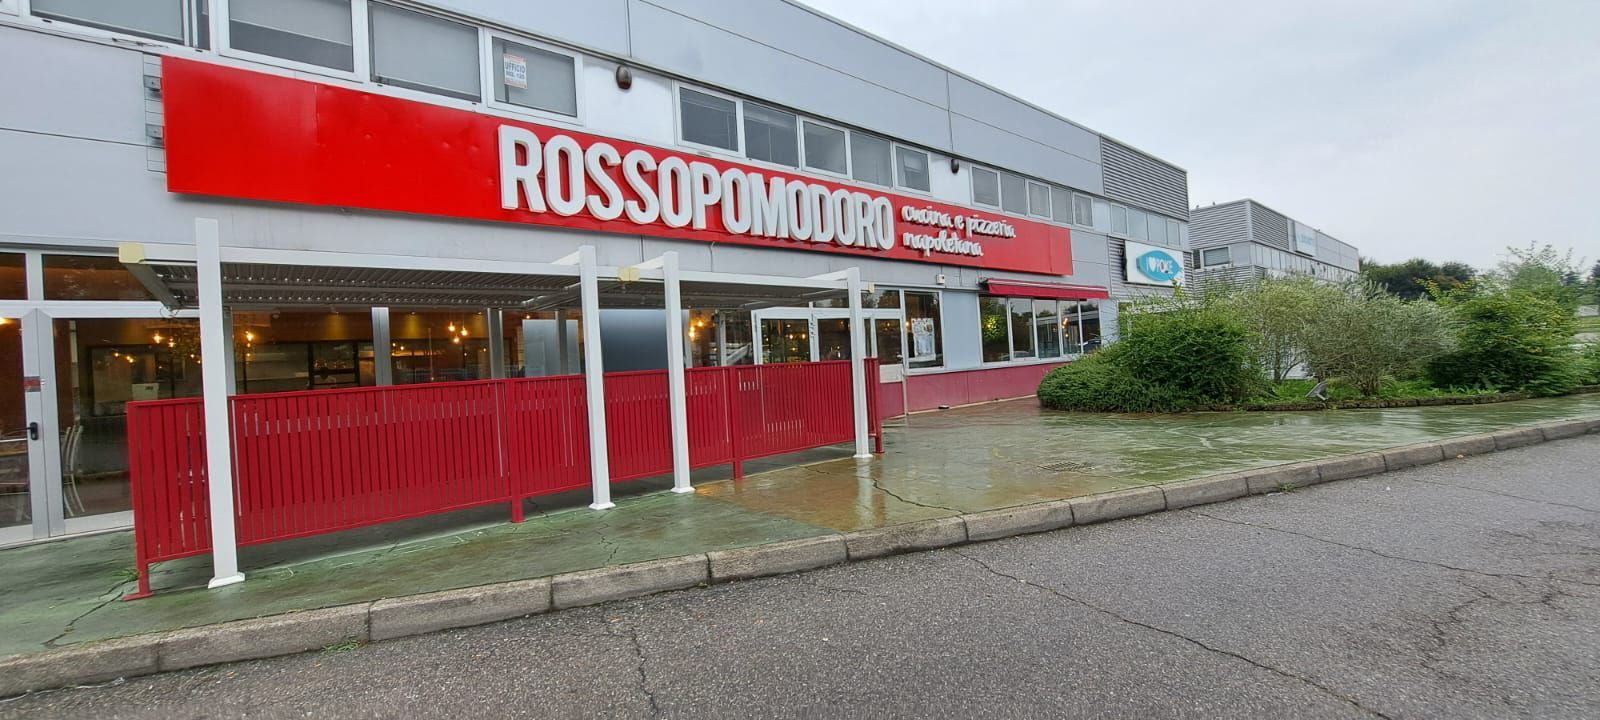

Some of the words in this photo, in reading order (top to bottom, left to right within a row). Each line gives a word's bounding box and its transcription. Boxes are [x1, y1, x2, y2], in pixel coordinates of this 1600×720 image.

[504, 61, 526, 74] UFFICIO
[497, 124, 895, 251] ROSSOPOMODORO
[901, 205, 954, 228] cucina
[954, 215, 965, 230] e
[965, 214, 1016, 238] pizzeria
[902, 230, 984, 257] napoletana
[1156, 258, 1174, 274] POKE
